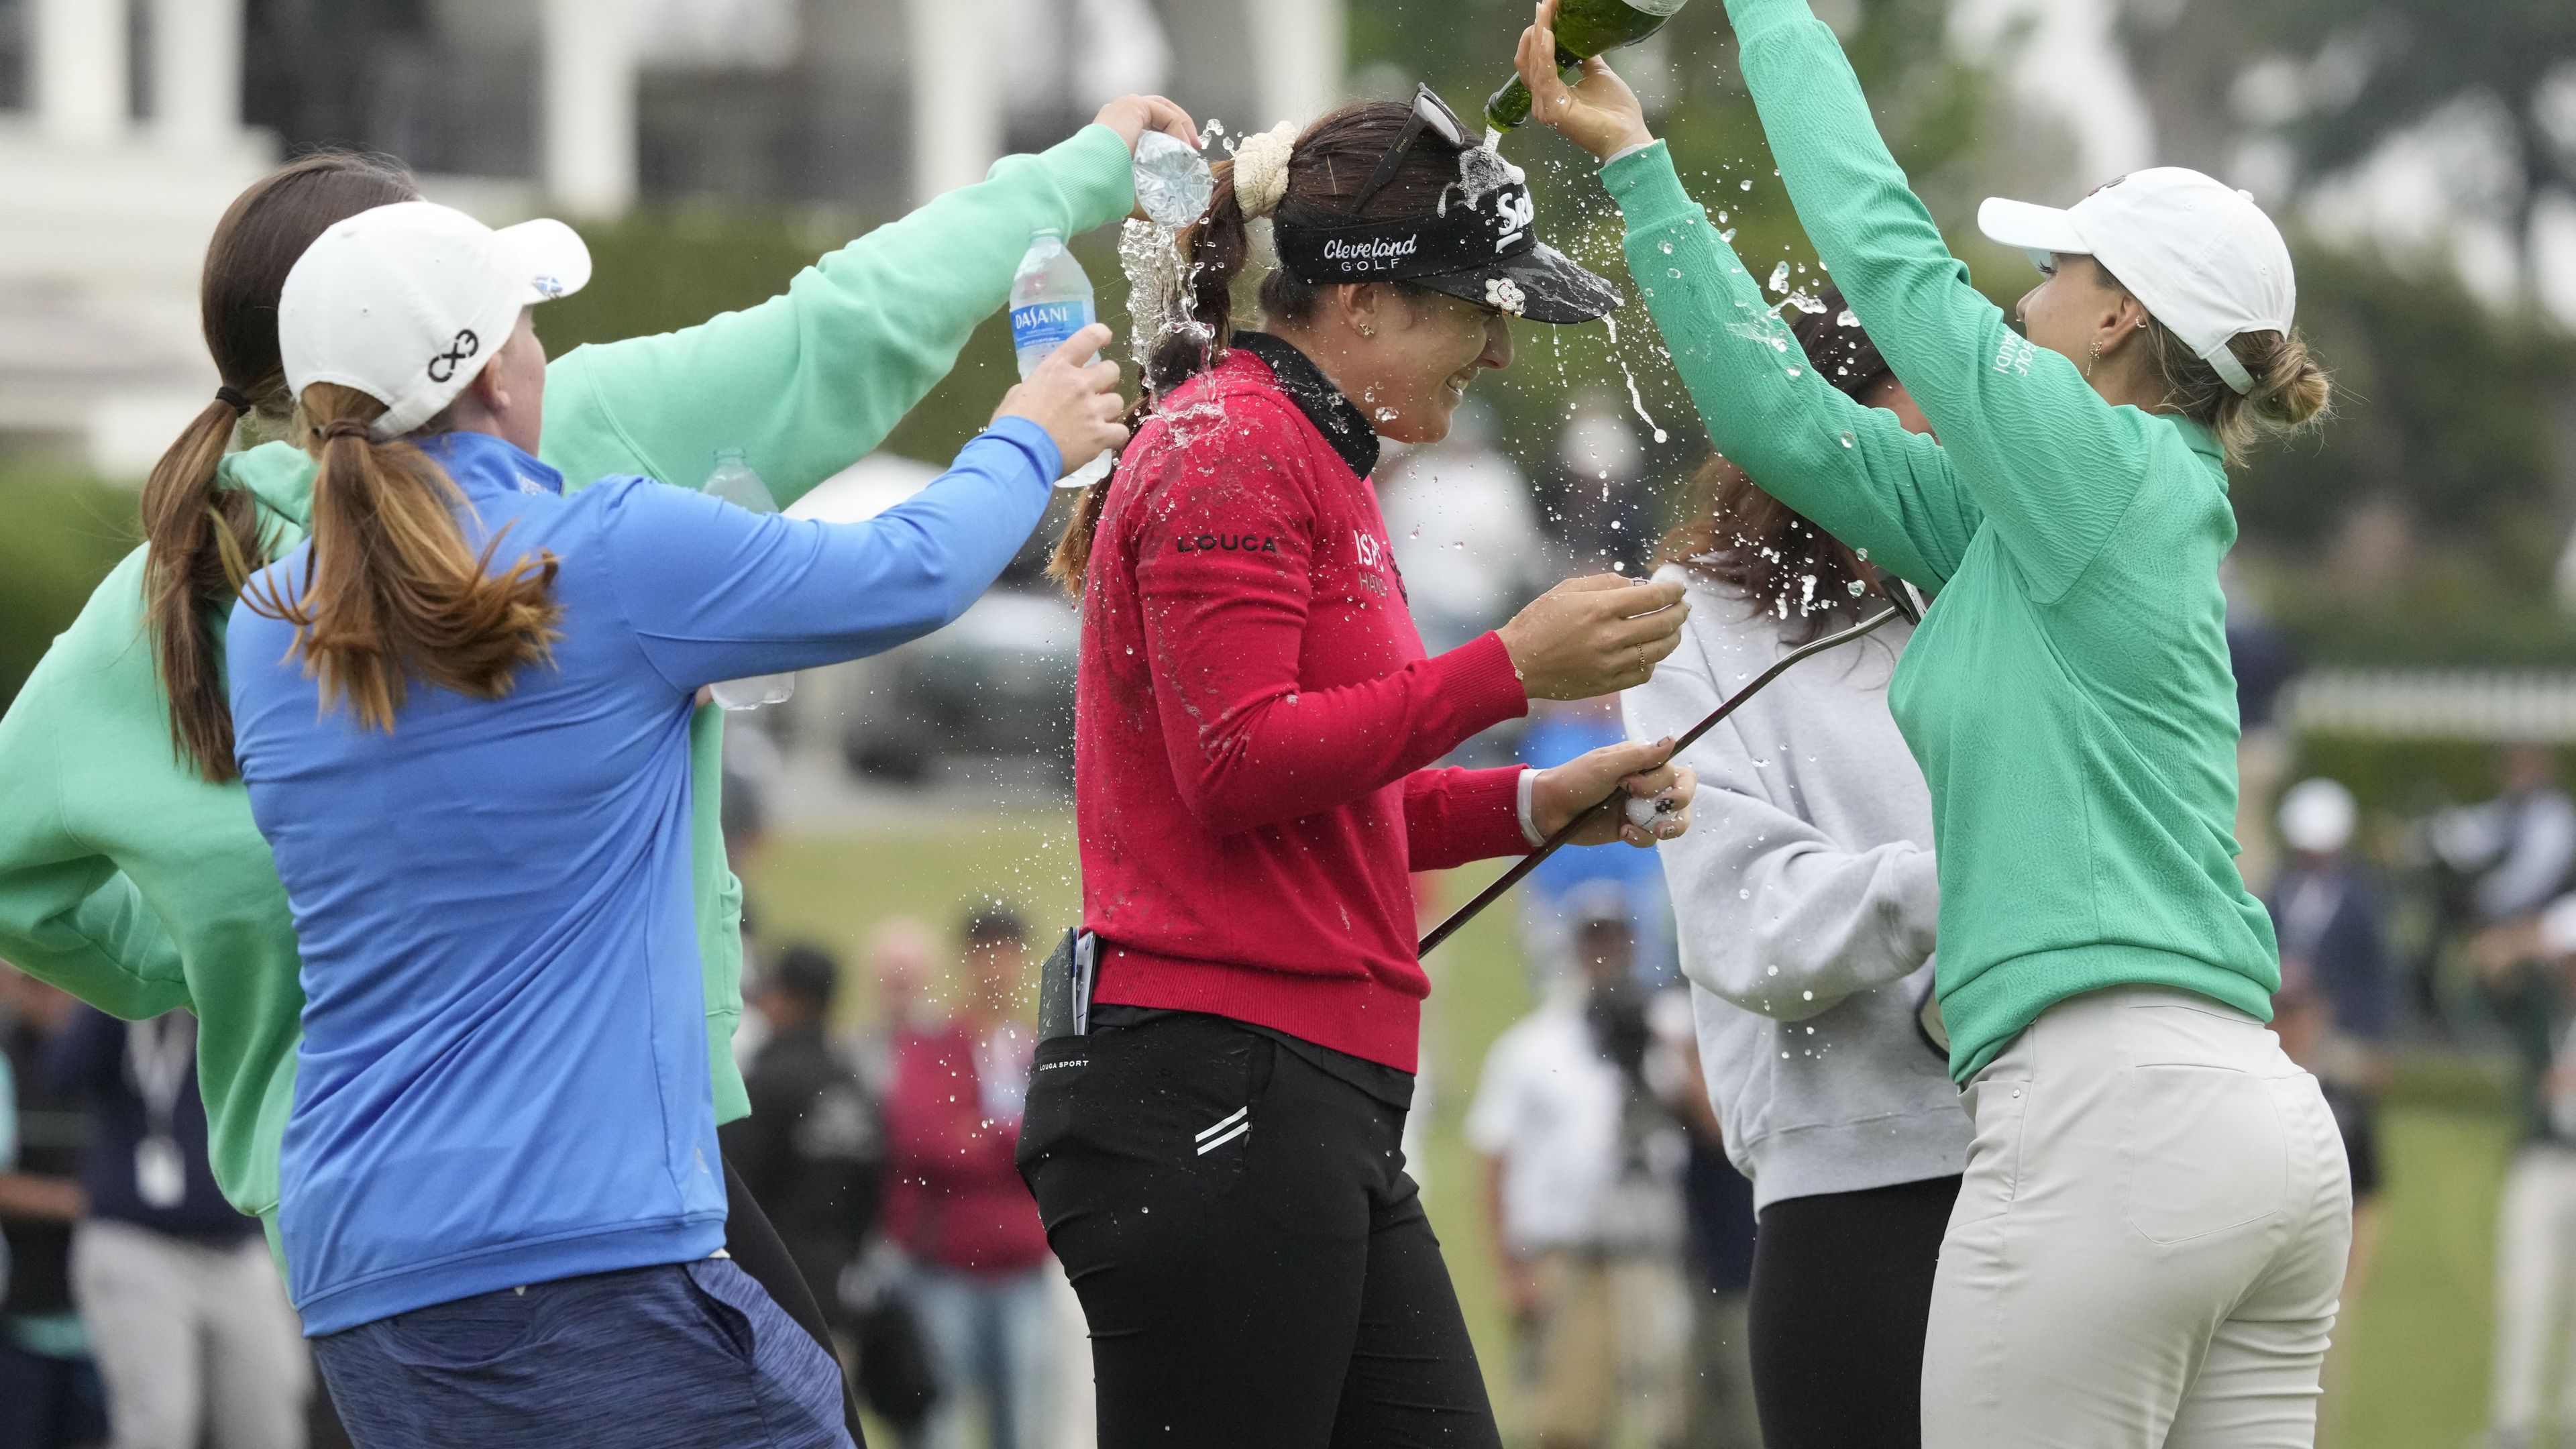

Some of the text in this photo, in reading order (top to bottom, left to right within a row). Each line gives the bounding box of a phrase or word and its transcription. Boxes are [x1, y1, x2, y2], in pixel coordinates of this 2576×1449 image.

[1324, 233, 1417, 260] Cleveland
[1341, 258, 1400, 272] GOLF
[1015, 307, 1068, 329] DASANI
[2014, 340, 2038, 377] GOLF
[1177, 533, 1277, 553] LOUCA
[1059, 1060, 1089, 1068] SPORT
